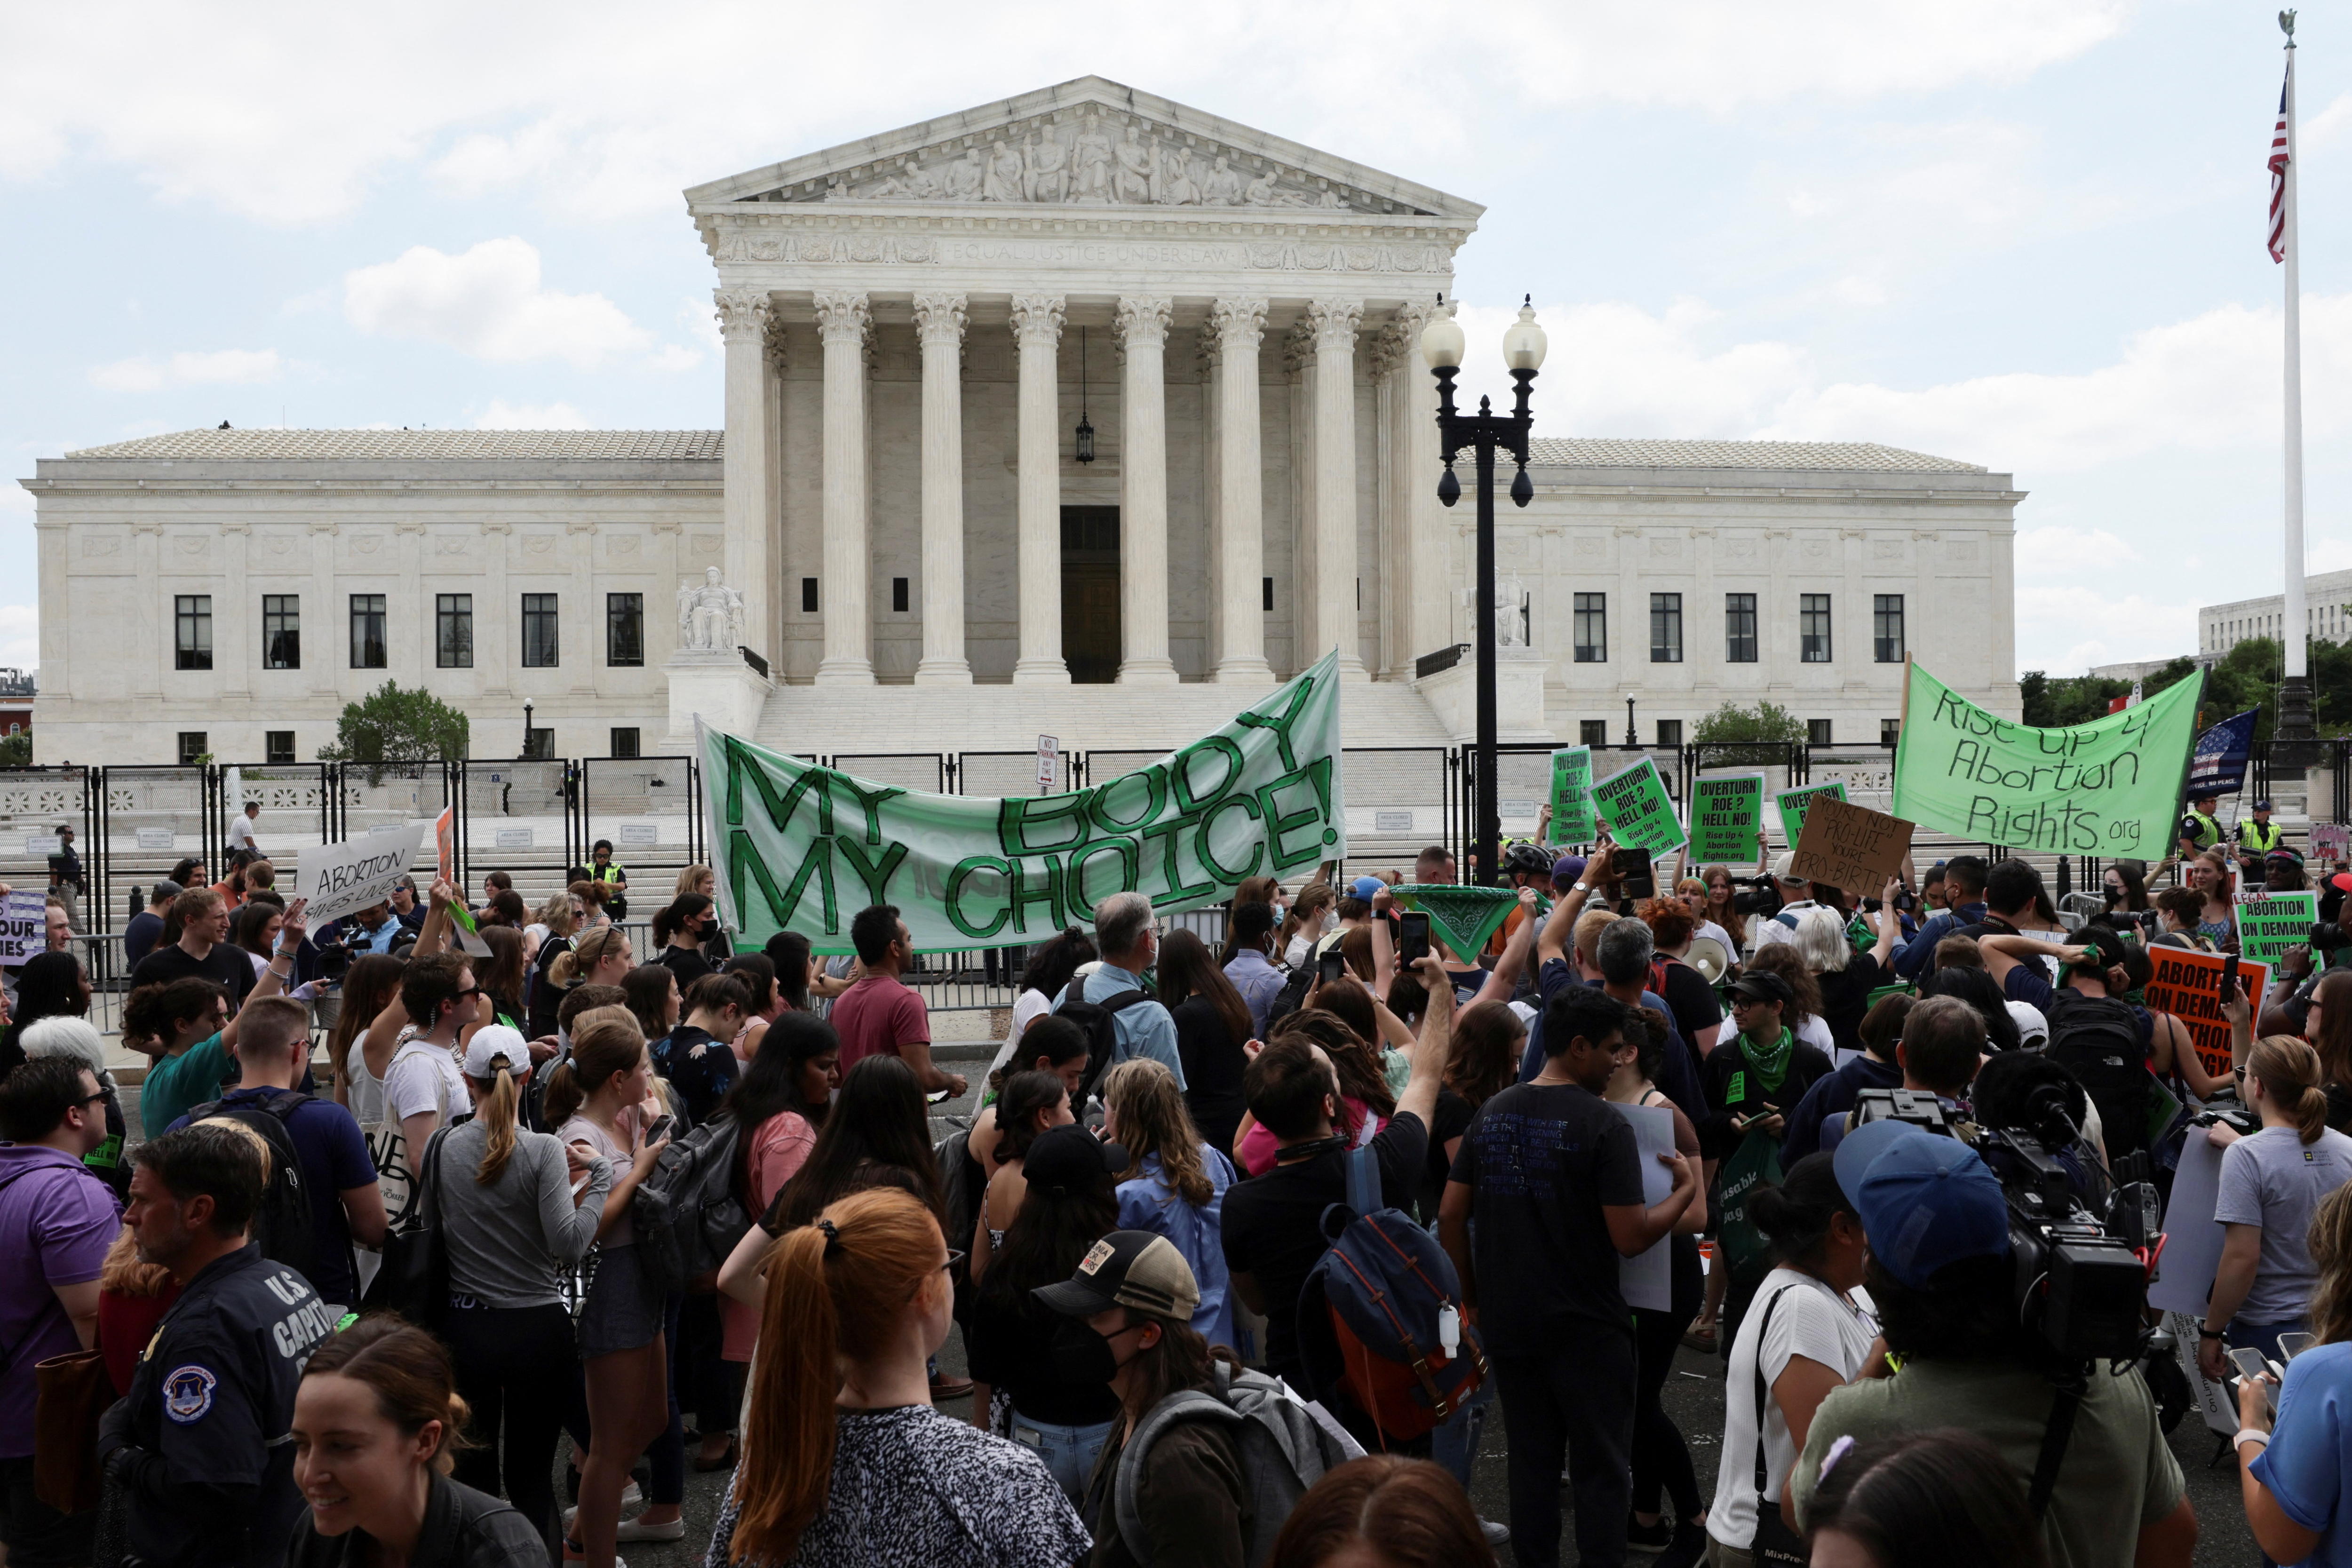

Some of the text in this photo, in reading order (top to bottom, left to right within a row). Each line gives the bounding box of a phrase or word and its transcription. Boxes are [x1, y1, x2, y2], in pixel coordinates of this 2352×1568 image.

[953, 244, 1231, 263] EQUAL JUSTICE UNDER LAW
[1933, 689, 2016, 743] Rise
[2122, 704, 2155, 747] 4
[1044, 739, 1052, 749] NO
[1039, 748, 1056, 760] PARKING
[1557, 753, 1588, 771] OVERTURN
[723, 677, 1314, 857] MY BODY
[1042, 767, 1051, 776] TIME
[1948, 739, 2139, 792] Abortion
[1566, 772, 1578, 787] ROE
[1597, 764, 1651, 802] OVERTURN
[1700, 779, 1756, 796] OVERTURN
[1559, 789, 1577, 804] HELL
[1615, 786, 1645, 812] ROE ?
[1711, 796, 1745, 812] ROE ?
[1561, 810, 1573, 819] Rise
[1574, 808, 1582, 818] Up
[1614, 796, 1661, 831] HELL NO!
[1702, 812, 1752, 827] HELL NO!
[1560, 820, 1585, 830] Abortion
[1628, 818, 1661, 841] Rise Up 4
[1866, 812, 1903, 833] NOT
[1558, 831, 1587, 844] Rights.org
[1635, 830, 1665, 850] Abortion
[1725, 831, 1736, 841] Up
[2310, 828, 2349, 843] WOMAN
[730, 829, 909, 935] MY
[946, 755, 1337, 938] CHOICE!
[1706, 841, 1741, 850] Abortion
[2312, 846, 2339, 859] WOMB
[1703, 852, 1745, 861] Rights.org
[318, 848, 405, 895] ABORTION
[1797, 851, 1887, 894] PRO-BIRTH
[304, 873, 404, 919] SAVES LIVES
[2233, 892, 2272, 905] LEGAL
[2246, 900, 2305, 916] ABORTION
[2241, 921, 2313, 937] ON DEMAND
[2249, 944, 2257, 956] &
[2156, 960, 2253, 998] ABORTN
[2145, 986, 2173, 1011] ON
[1501, 1123, 1518, 1132] THE
[1505, 1113, 1525, 1124] FIRE
[1527, 1117, 1547, 1127] WITH
[1549, 1120, 1568, 1130] FIRE
[1485, 1133, 1509, 1142] WHOM
[1530, 1138, 1548, 1148] BELL
[1551, 1140, 1580, 1152] TOLLS
[383, 1191, 405, 1202] YORKER
[264, 1271, 310, 1305] U.S.
[2209, 1398, 2217, 1413] On
